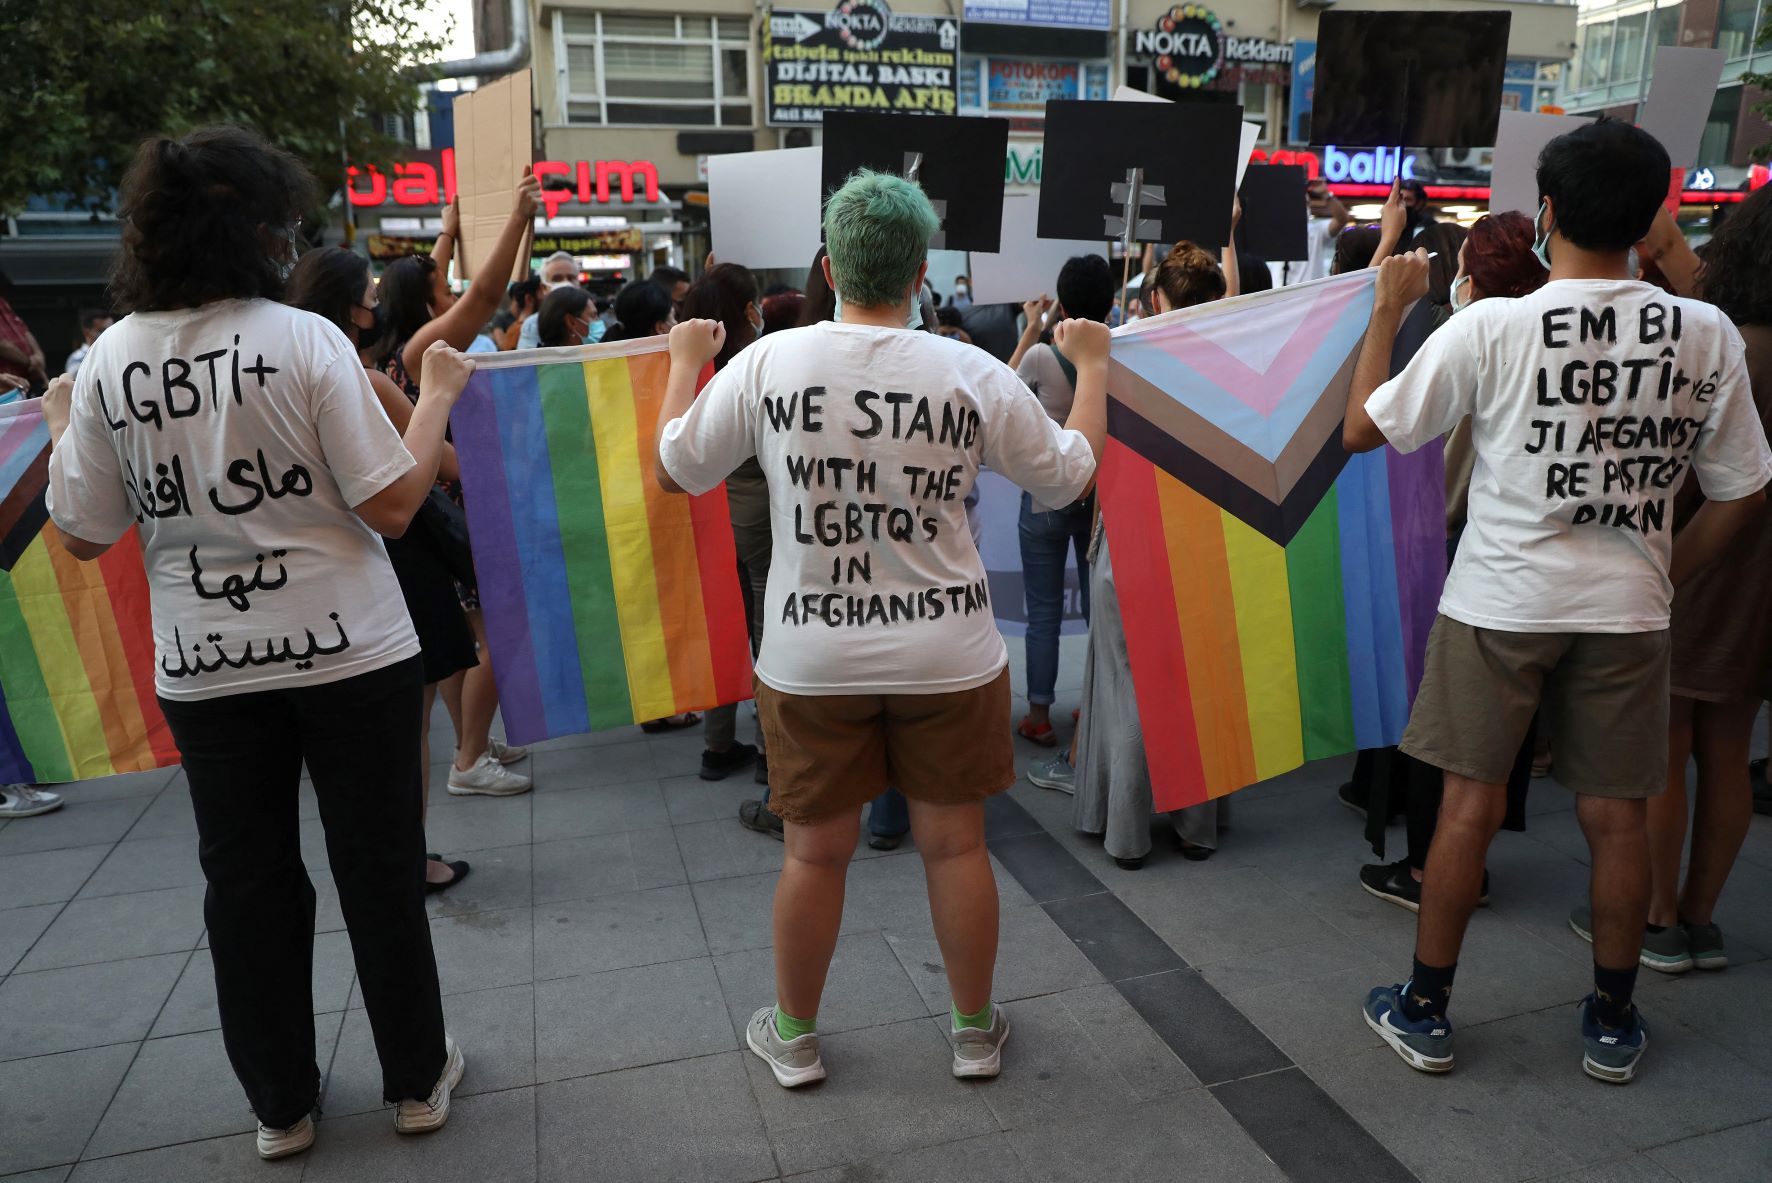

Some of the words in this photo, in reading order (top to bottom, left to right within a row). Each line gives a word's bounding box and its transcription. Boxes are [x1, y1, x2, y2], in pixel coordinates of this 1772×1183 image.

[824, 12, 881, 32] NOKTA
[1135, 31, 1213, 58] NOKTA
[1226, 36, 1293, 63] Reklam
[777, 60, 873, 83] DİJİTAL
[877, 64, 951, 86] BASKI
[773, 83, 889, 107] BRANDA
[894, 86, 956, 114] AFİŞ
[1324, 144, 1416, 185] balık
[1542, 306, 1617, 349] EM
[764, 386, 827, 433] WE
[850, 390, 980, 450] STAND
[1524, 420, 1567, 454] JI
[208, 448, 313, 515] های
[786, 455, 877, 494] WITH
[903, 464, 964, 502] THE
[1546, 461, 1590, 500] RE
[795, 500, 938, 548] LGBTQ's
[189, 543, 288, 612] تنها
[831, 551, 872, 585] IN
[782, 577, 989, 627] AFGHANISTAN
